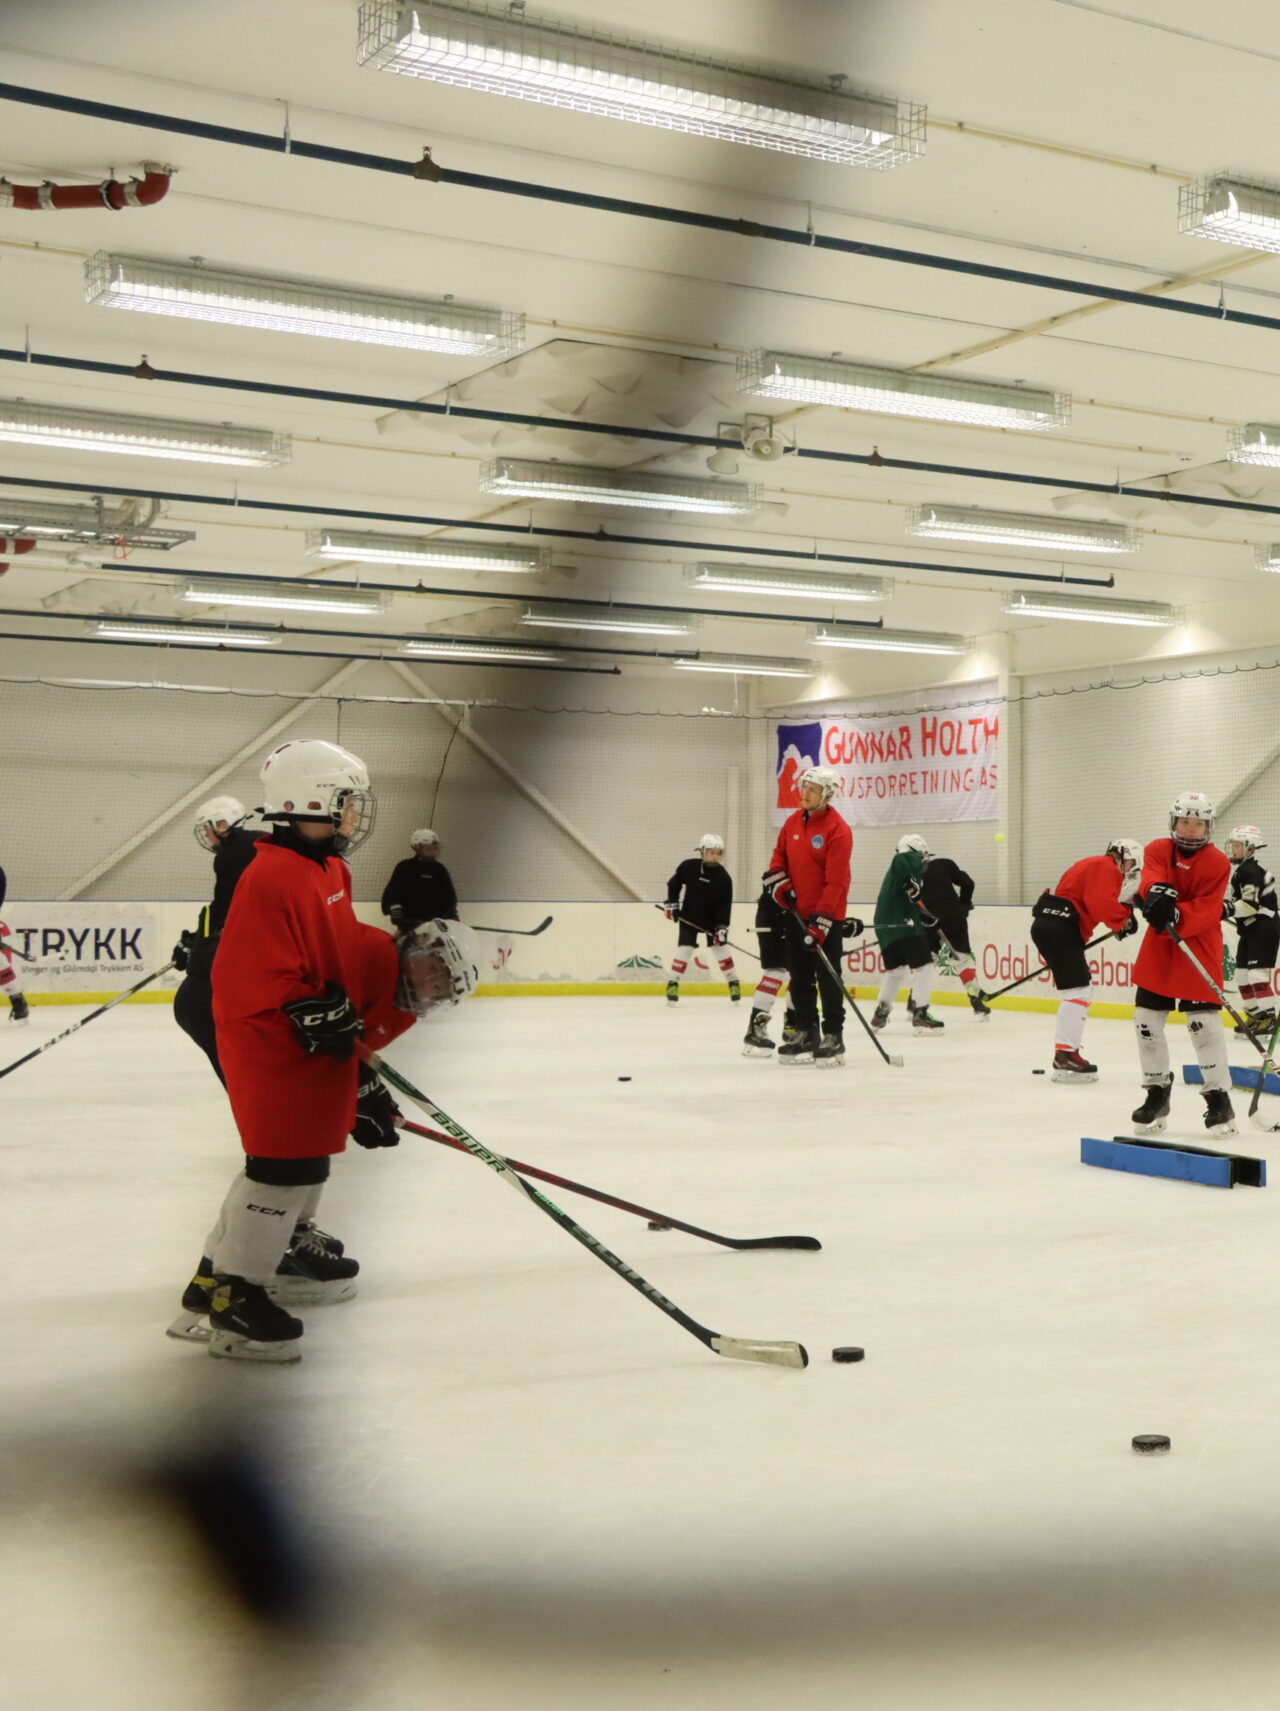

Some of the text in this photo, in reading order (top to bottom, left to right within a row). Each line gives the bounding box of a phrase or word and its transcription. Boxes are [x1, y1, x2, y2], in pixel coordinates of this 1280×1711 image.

[825, 716, 999, 765] GUNNAR HOLTH
[836, 765, 998, 800] RUSFORRETNING AS
[1149, 885, 1179, 898] CC
[1042, 907, 1071, 918] CCM
[16, 927, 143, 961] TRYKK
[983, 943, 1030, 981] Odal
[304, 996, 350, 1026] CC
[246, 1203, 287, 1217] CCM
